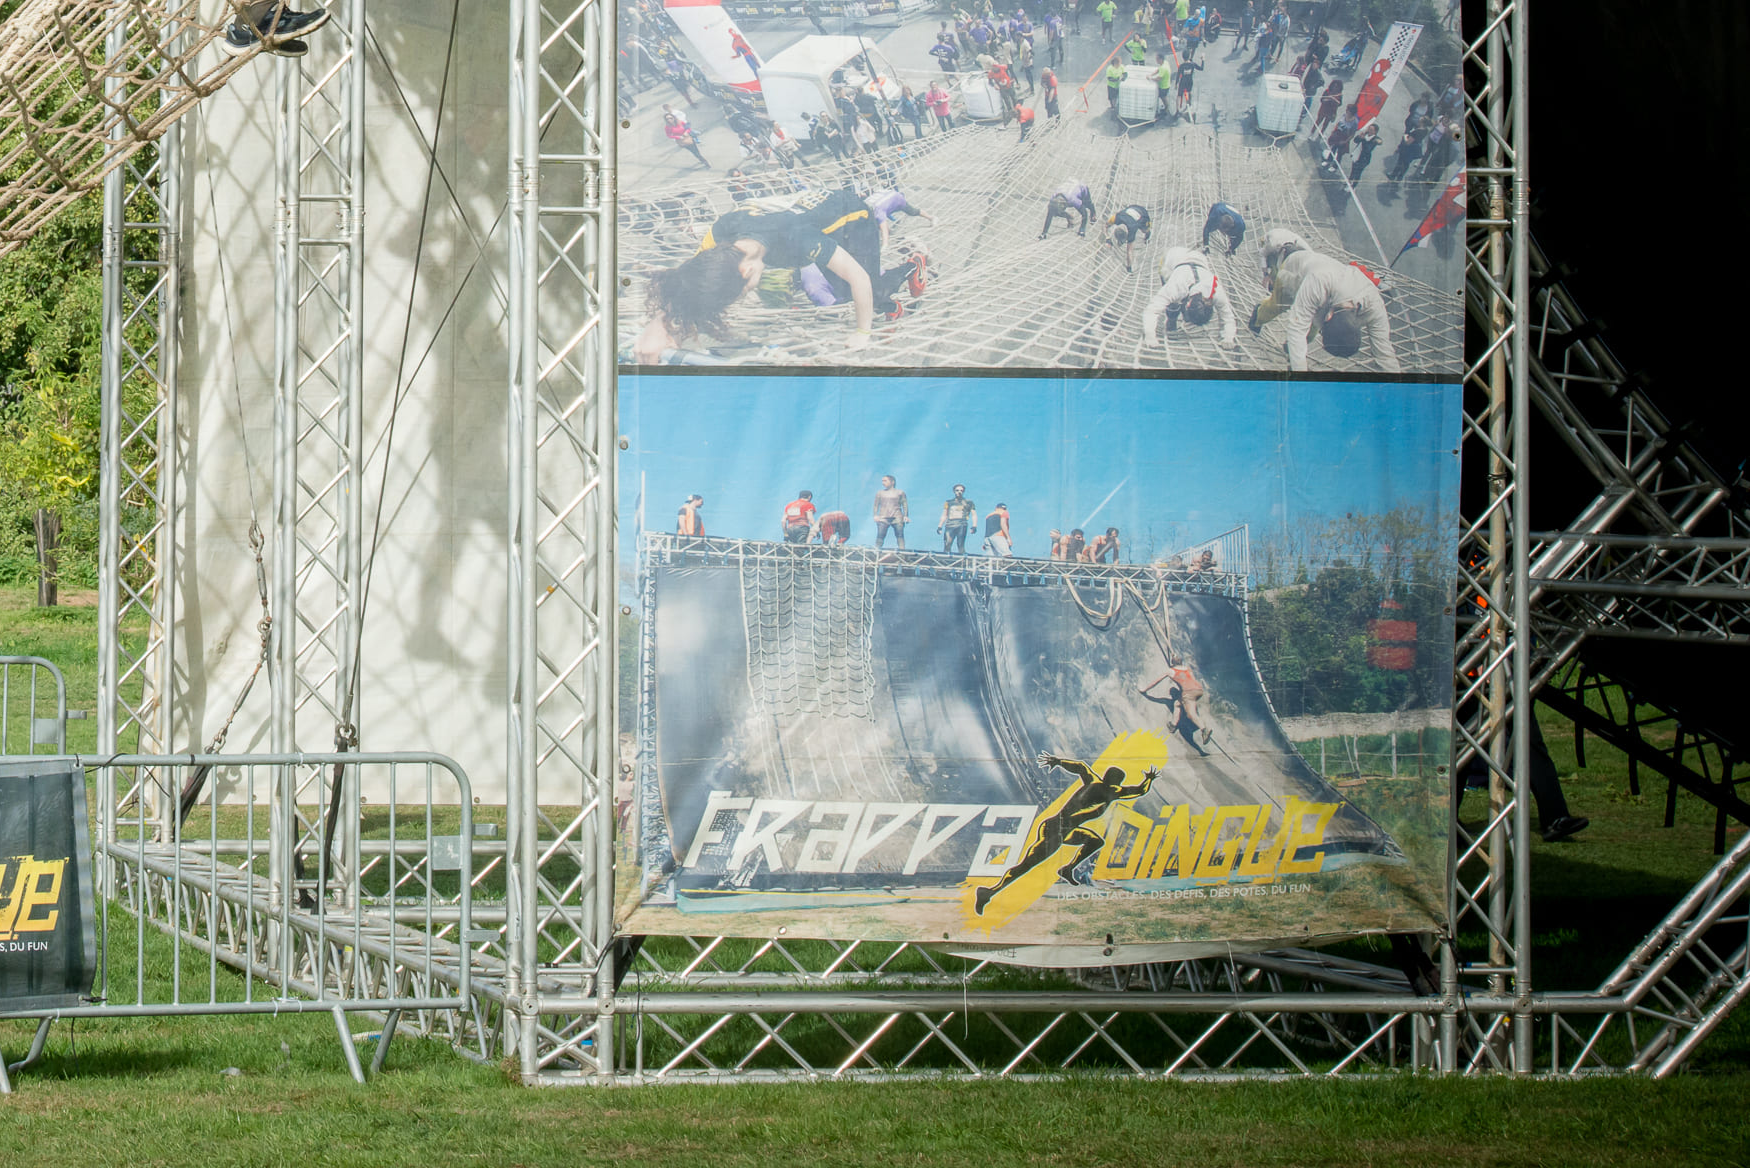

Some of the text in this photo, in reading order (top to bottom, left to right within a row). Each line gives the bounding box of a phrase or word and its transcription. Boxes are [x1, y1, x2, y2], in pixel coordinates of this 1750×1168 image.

[1057, 891, 1078, 901] DES
[1150, 889, 1170, 900] DES
[1209, 888, 1231, 898] DES
[1271, 885, 1286, 895] DU
[1288, 884, 1311, 894] FUN
[10, 941, 25, 952] DU
[27, 941, 48, 951] FUN
